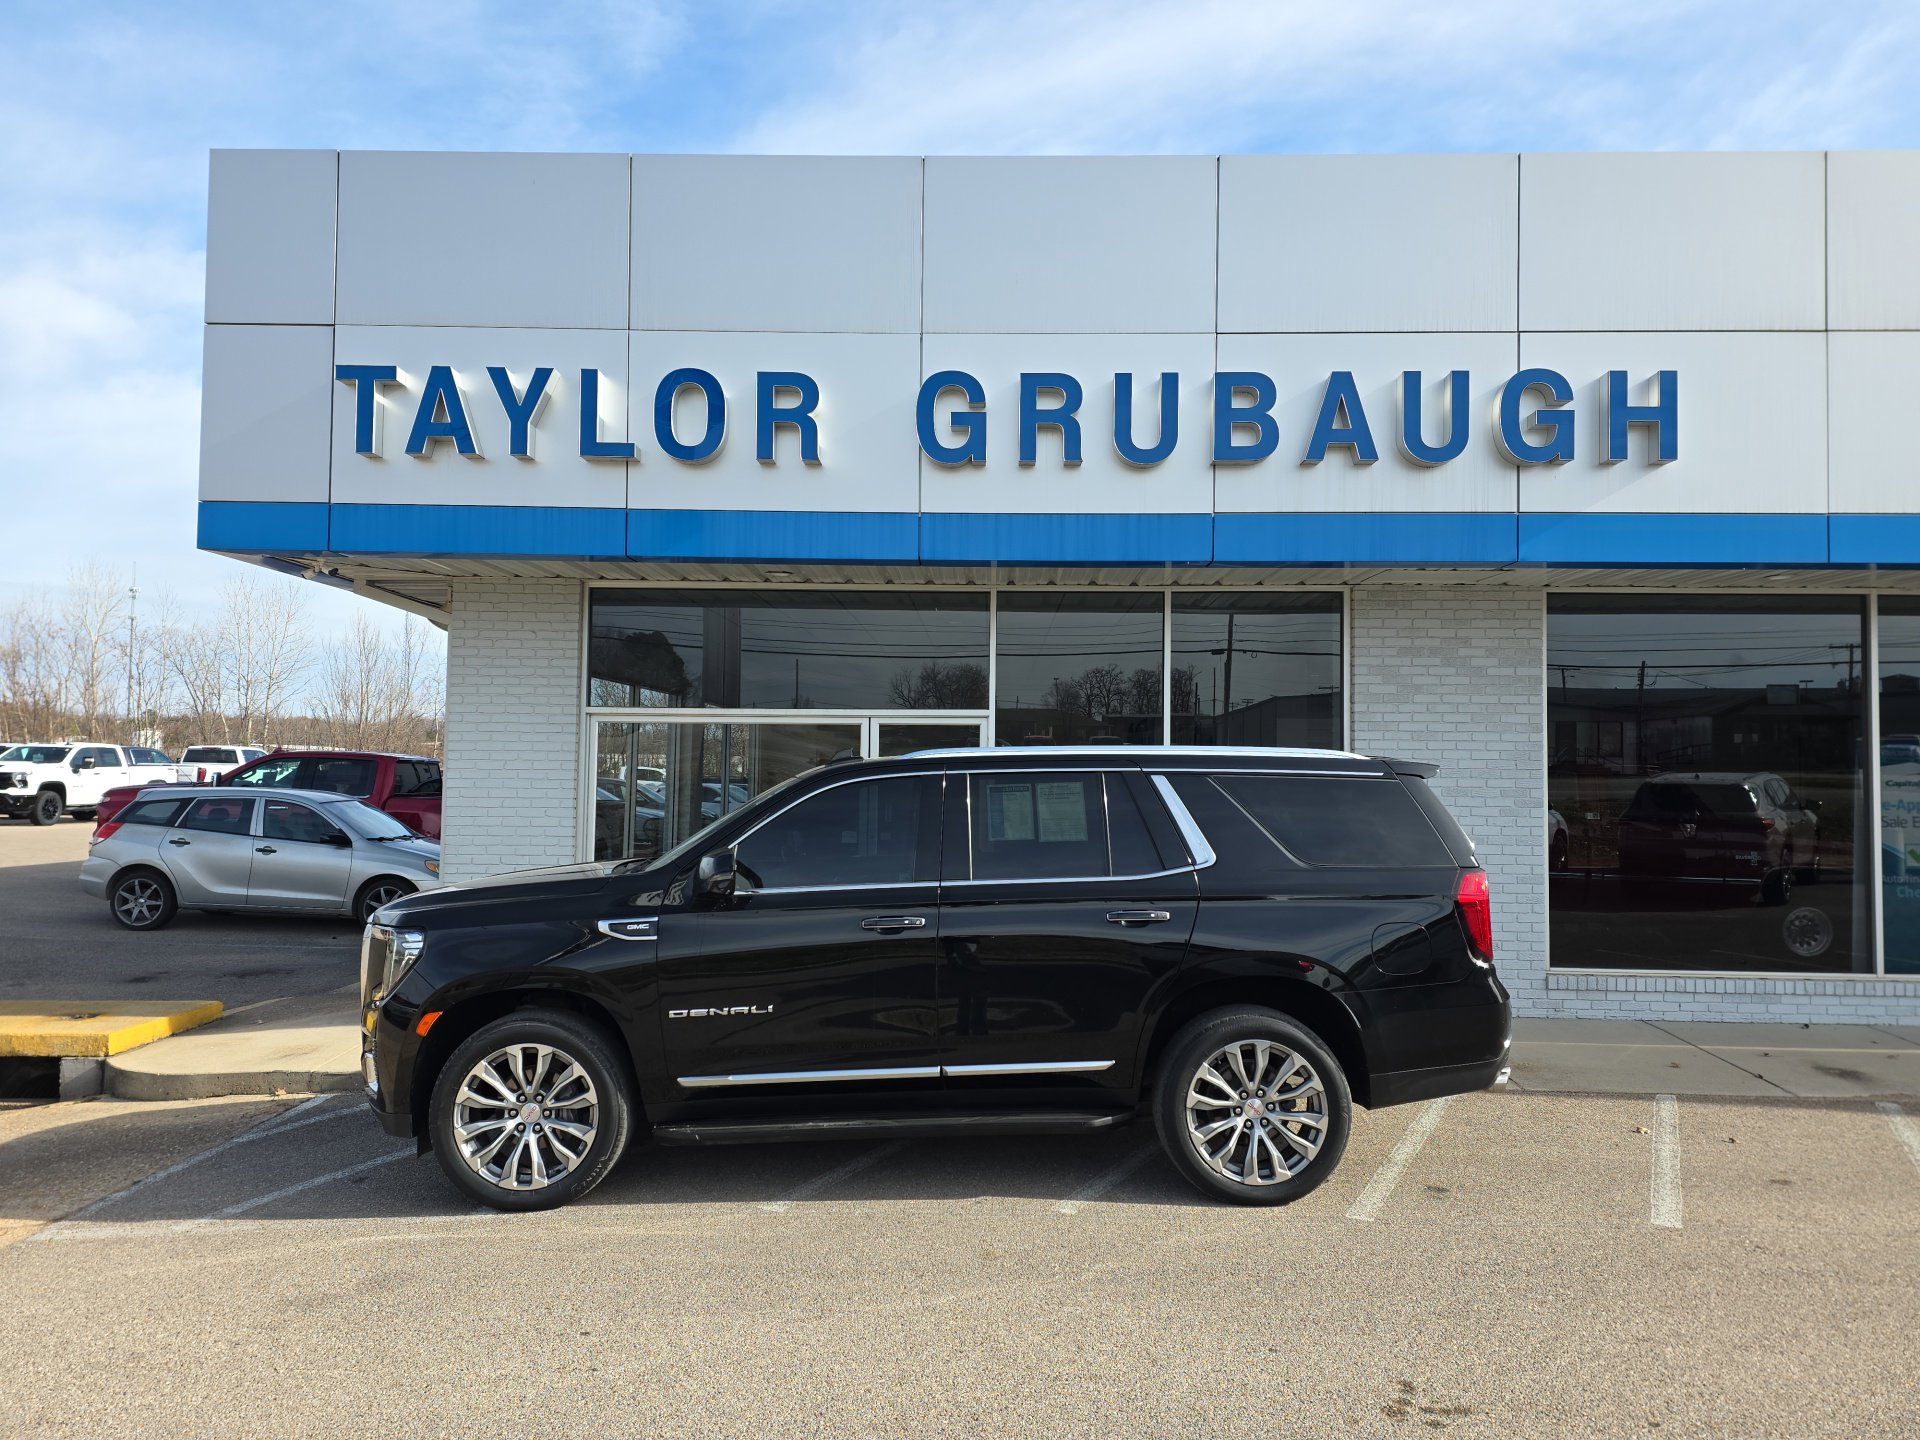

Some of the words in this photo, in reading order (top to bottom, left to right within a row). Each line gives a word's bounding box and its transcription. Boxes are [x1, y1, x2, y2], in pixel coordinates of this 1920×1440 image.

[335, 364, 822, 466] TAYLOR
[916, 368, 1678, 467] GRUBAUGH
[1881, 816, 1908, 828] Sale
[626, 923, 650, 931] GMC
[668, 1004, 774, 1019] DENALI
